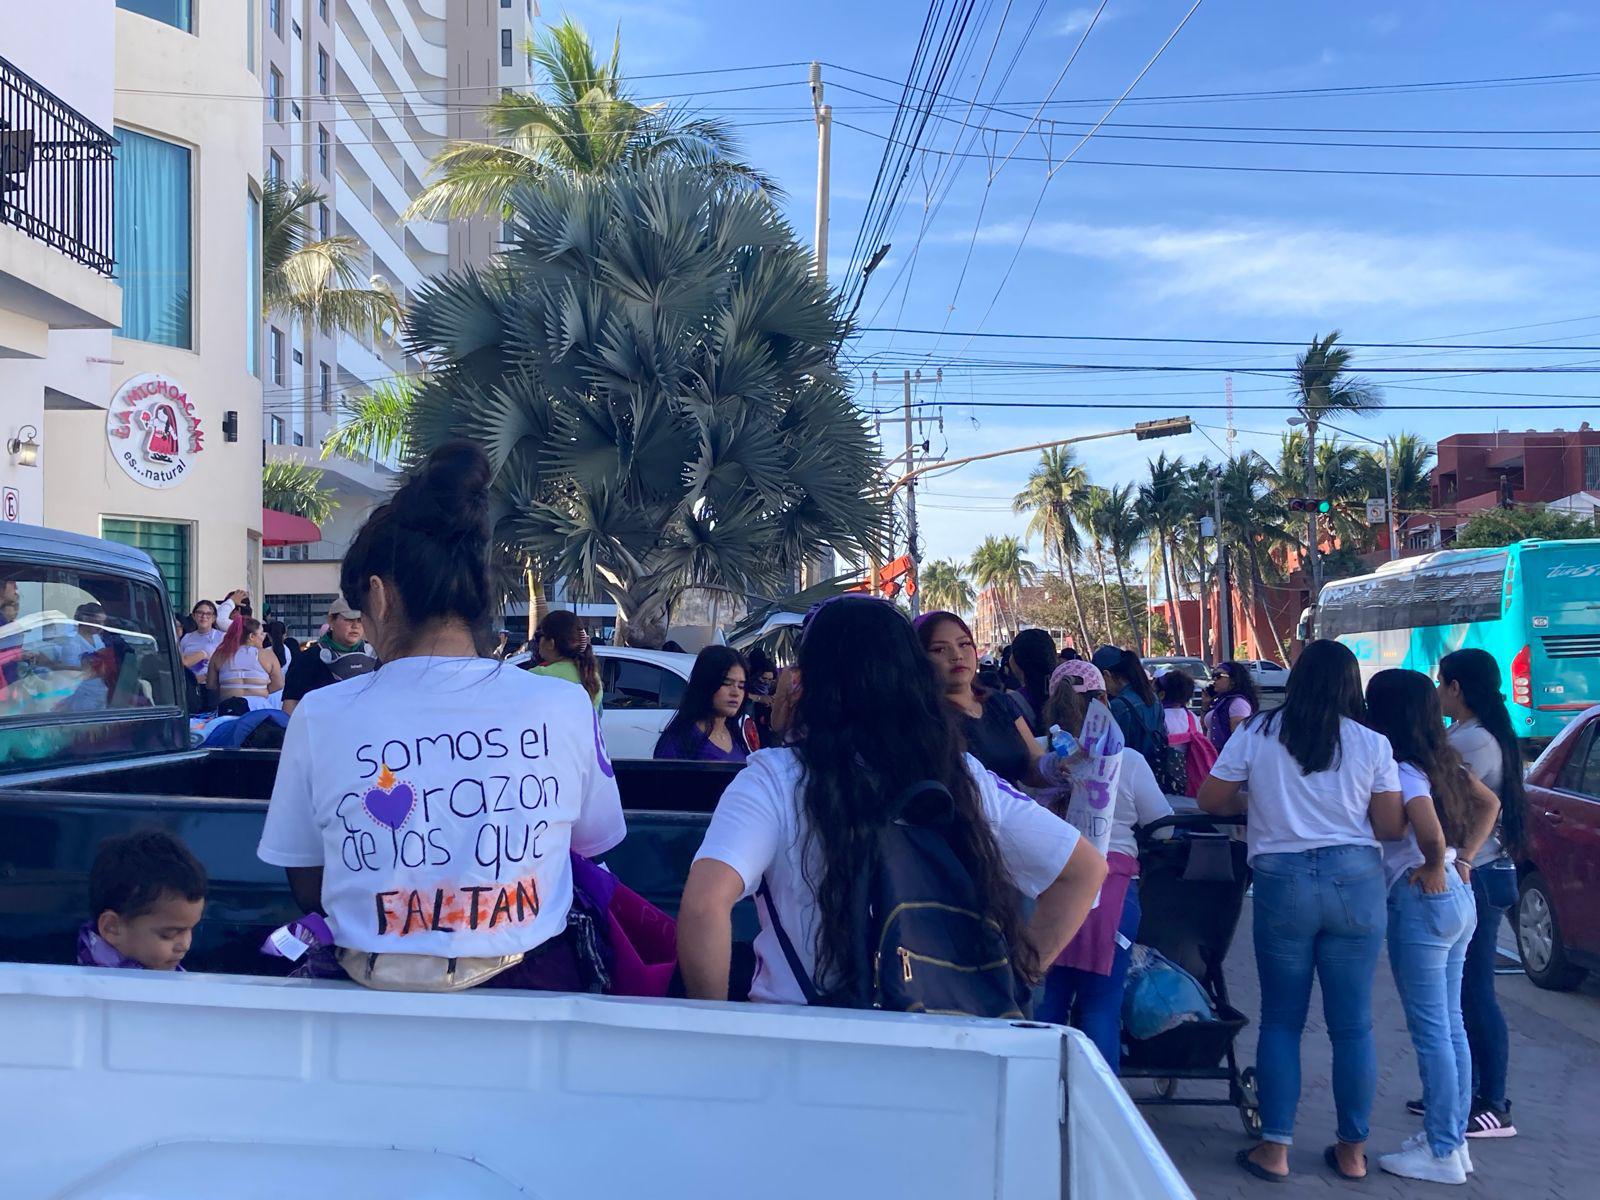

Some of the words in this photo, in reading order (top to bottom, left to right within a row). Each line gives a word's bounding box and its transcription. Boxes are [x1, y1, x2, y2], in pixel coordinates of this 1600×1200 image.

[122, 380, 204, 453] MICHOACANA
[520, 723, 549, 759] el
[342, 823, 380, 872] de
[391, 821, 452, 870] las
[475, 820, 549, 880] que
[375, 878, 540, 936] FALTAN
